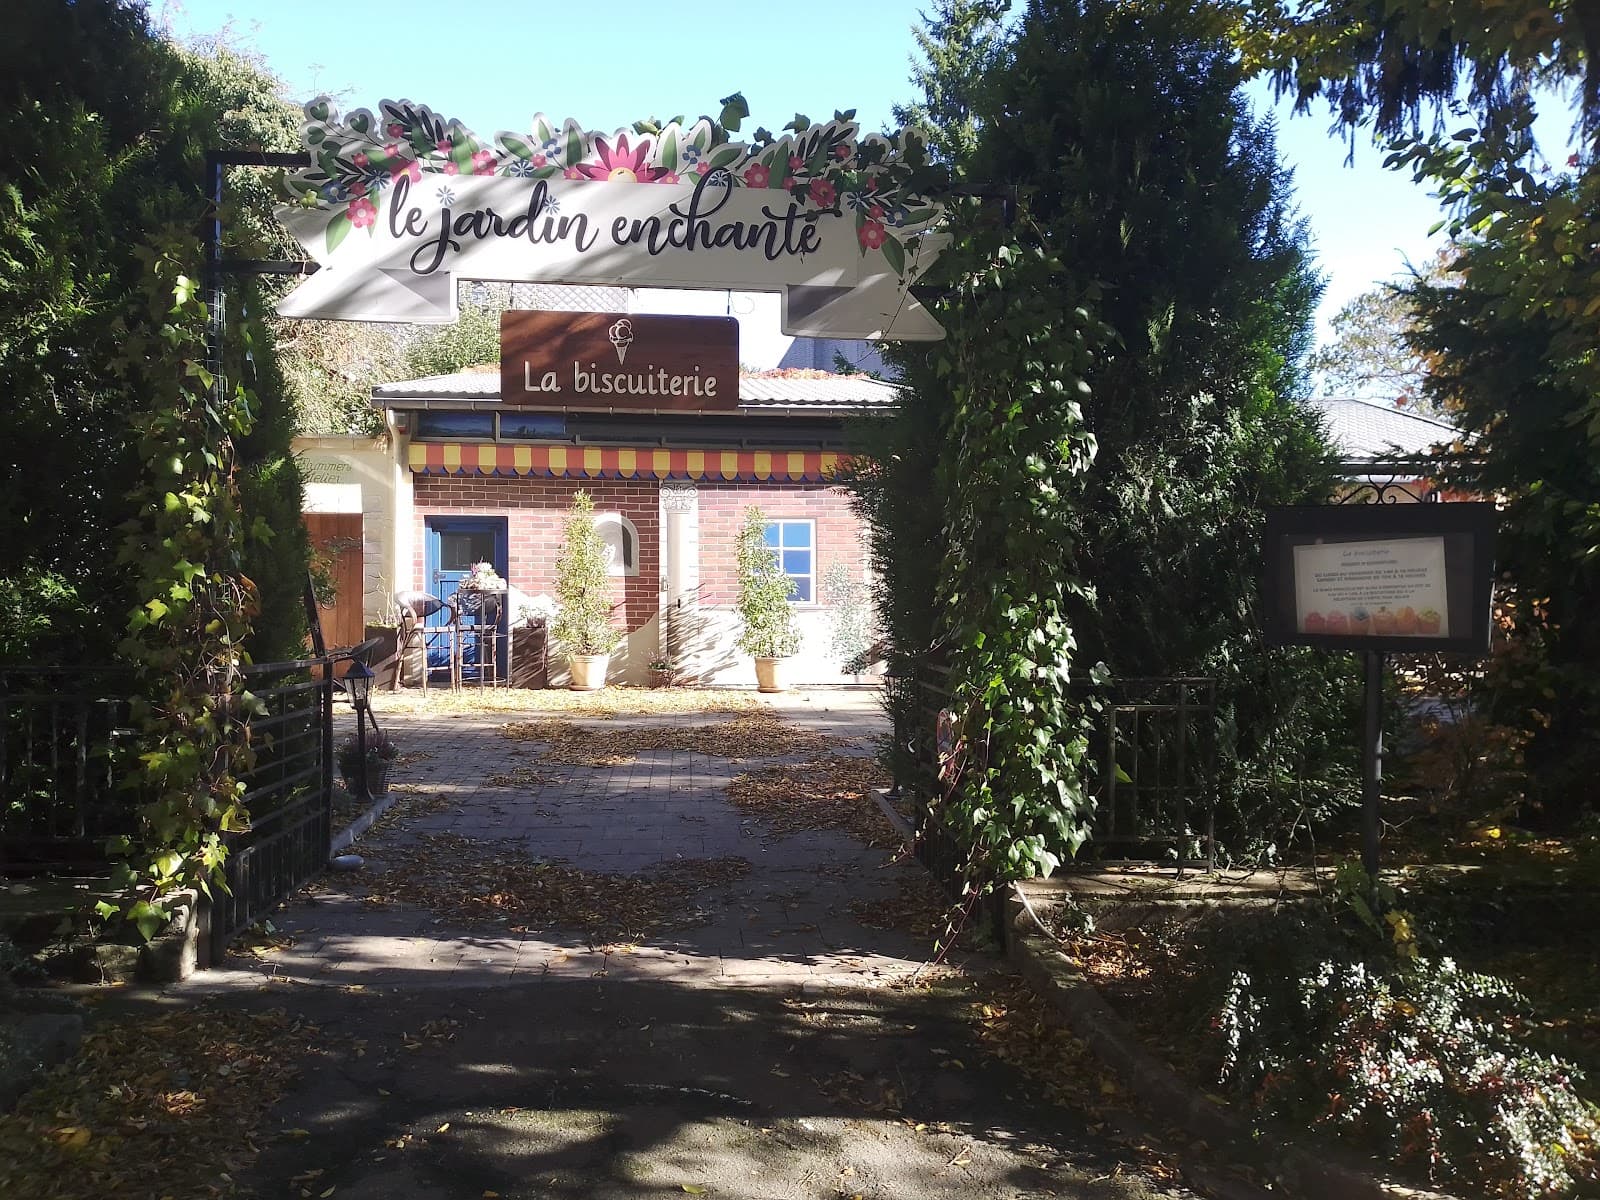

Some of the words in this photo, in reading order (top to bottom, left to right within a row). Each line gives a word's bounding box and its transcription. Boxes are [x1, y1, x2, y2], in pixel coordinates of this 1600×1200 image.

[389, 174, 427, 239] le
[410, 180, 599, 275] jardin
[524, 361, 562, 393] La
[574, 361, 717, 397] biscuiterie
